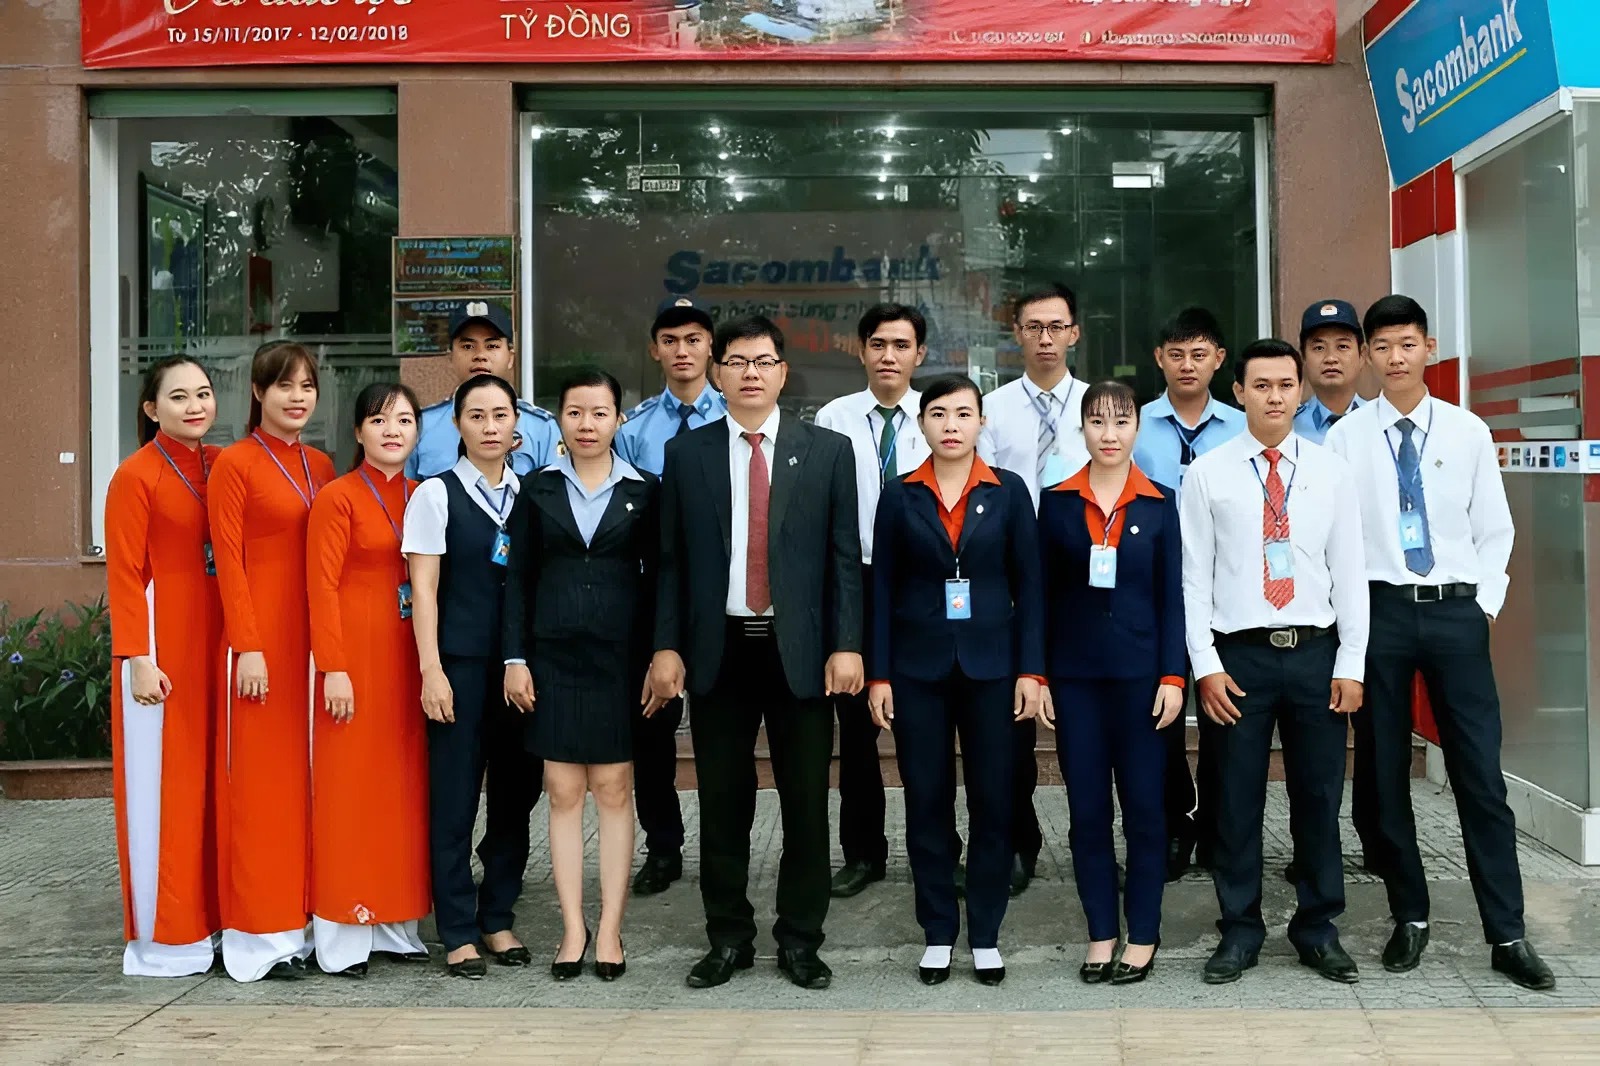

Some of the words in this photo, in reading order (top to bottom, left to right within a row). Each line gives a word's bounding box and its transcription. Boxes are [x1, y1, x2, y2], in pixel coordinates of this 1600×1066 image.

[193, 26, 292, 44] 15/11/2017
[310, 25, 408, 43] 12/02/2018
[544, 4, 631, 38] ĐỒNG
[1395, 0, 1523, 134] Sacombank
[663, 245, 940, 293] Sacombank
